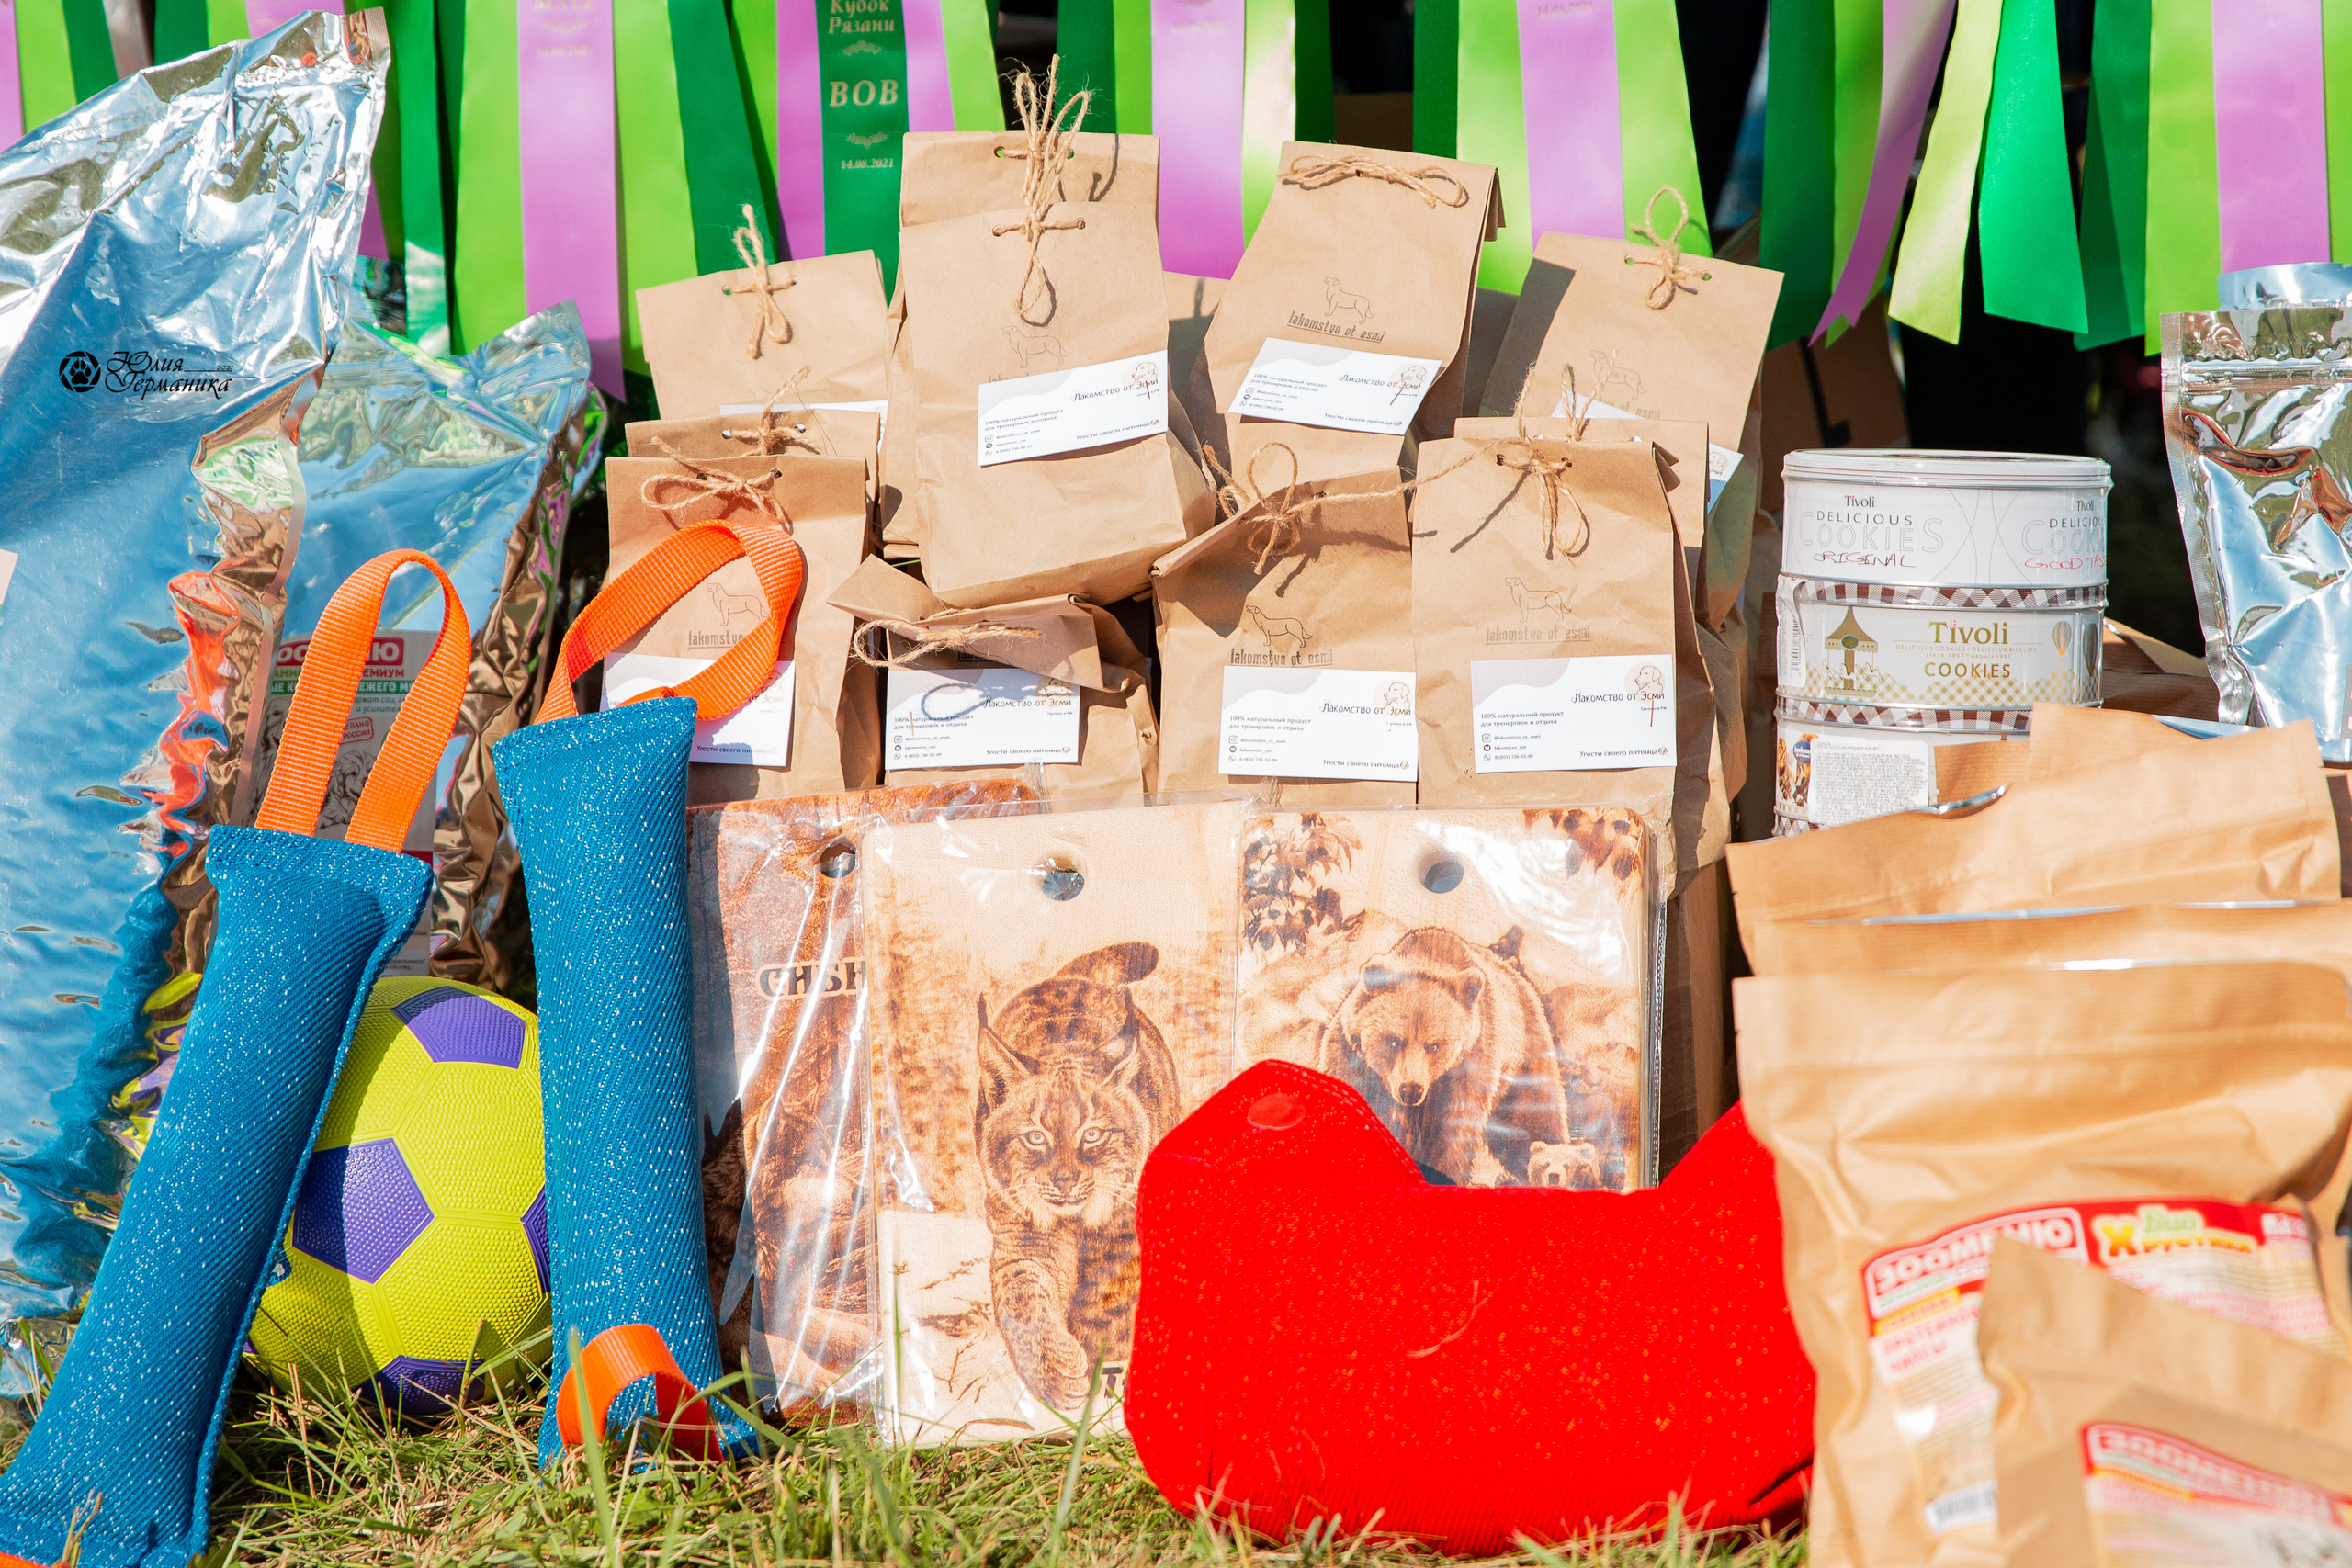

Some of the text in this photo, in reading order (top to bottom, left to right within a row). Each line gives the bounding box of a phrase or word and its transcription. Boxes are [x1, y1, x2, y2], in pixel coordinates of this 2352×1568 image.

[831, 0, 888, 18] Кубок
[829, 17, 895, 34] Рязани
[842, 157, 893, 169] 14.08.2021
[1288, 310, 1385, 342] lakomstvo ot esmi
[1339, 374, 1385, 386] Лакомство
[1072, 387, 1120, 401] Лакомство
[1845, 495, 1875, 508] Tivoli
[2076, 499, 2094, 511] Tivoli
[1816, 511, 1913, 525] DELICIOUS
[1800, 511, 1944, 553] COOKIES
[2024, 557, 2083, 570] GOOD
[1486, 625, 1590, 641] lakomstvo ot esmi
[1928, 619, 2009, 644] Tivoli
[1230, 648, 1332, 666] lakomstvo ot esmi
[362, 668, 404, 678] ЕМИУМ
[1924, 662, 2011, 678] COOKIES
[359, 682, 395, 693] ЕЖЕГО
[984, 699, 1032, 708] Лакомство
[1048, 697, 1071, 706] Эсми
[1574, 693, 1623, 704] Лакомство
[1640, 691, 1665, 701] Эсми
[1322, 703, 1371, 715] Лакомство
[345, 720, 370, 729] ЕЛАНО
